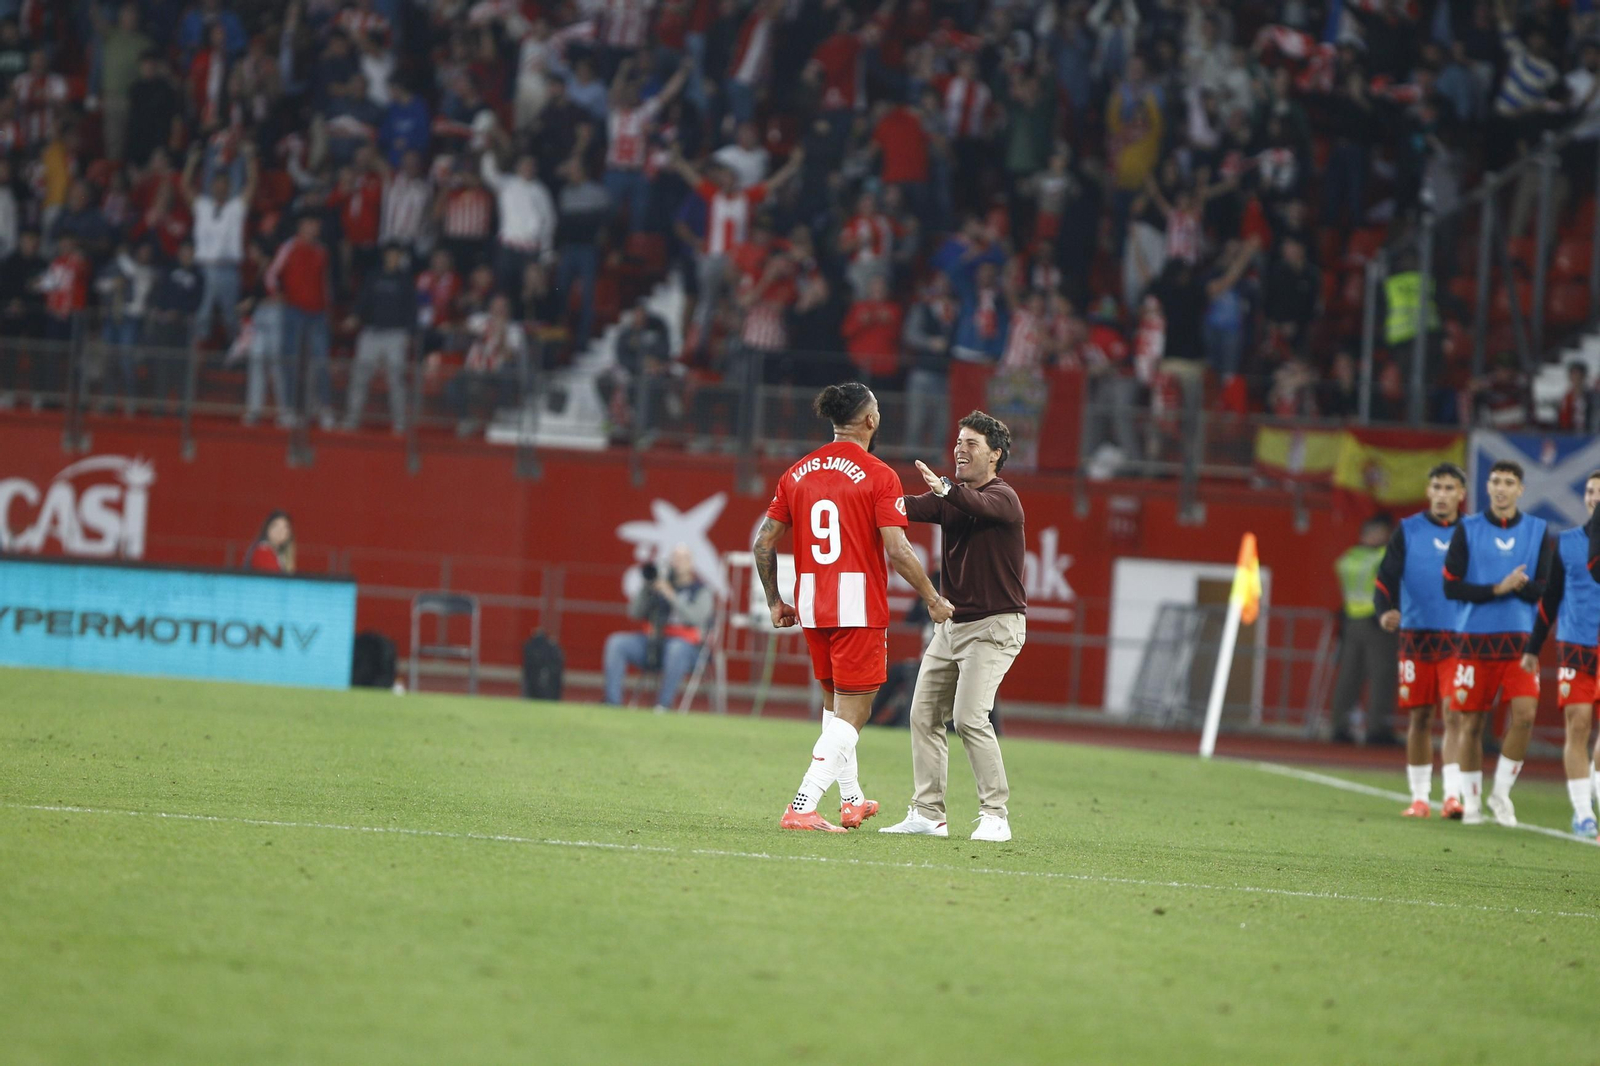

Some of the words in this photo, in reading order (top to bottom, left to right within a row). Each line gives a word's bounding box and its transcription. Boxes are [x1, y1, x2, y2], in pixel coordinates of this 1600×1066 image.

[791, 457, 821, 483] LUIS
[822, 456, 867, 485] JAVIER
[810, 499, 842, 565] 9
[1453, 663, 1475, 689] 34
